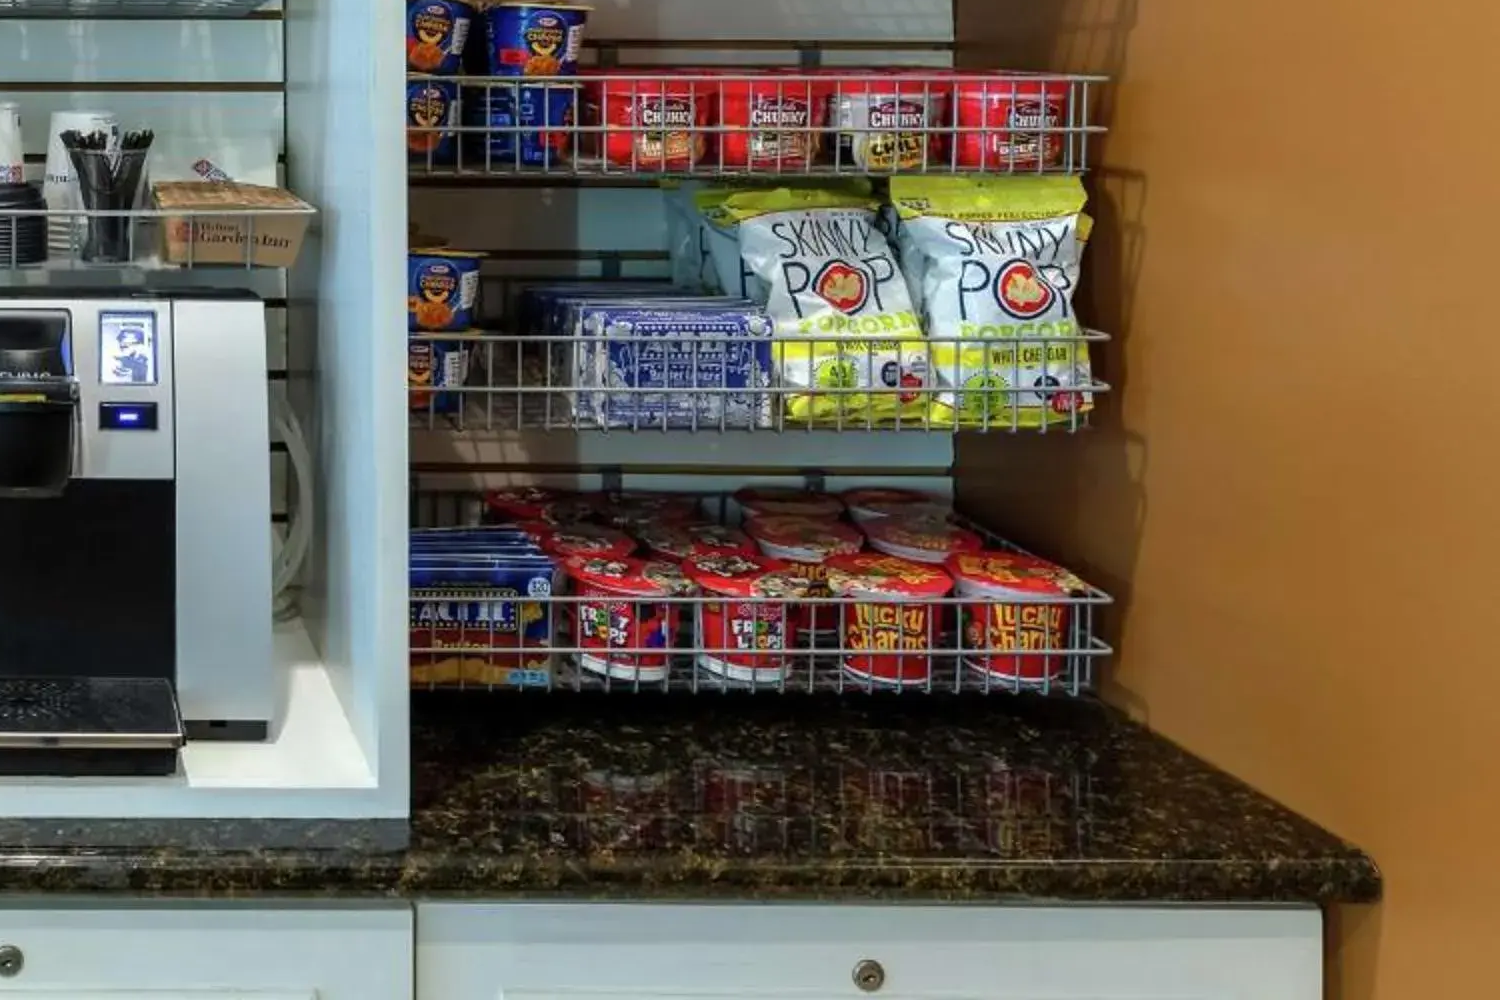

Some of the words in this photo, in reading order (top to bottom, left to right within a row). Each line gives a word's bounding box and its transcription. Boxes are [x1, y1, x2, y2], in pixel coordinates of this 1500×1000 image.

[200, 231, 259, 246] Gardn
[771, 217, 872, 259] SKINNY
[946, 221, 1069, 258] SKINNY
[783, 256, 895, 318] POP
[959, 258, 1072, 321] POP
[1023, 346, 1068, 364] CHEDAR
